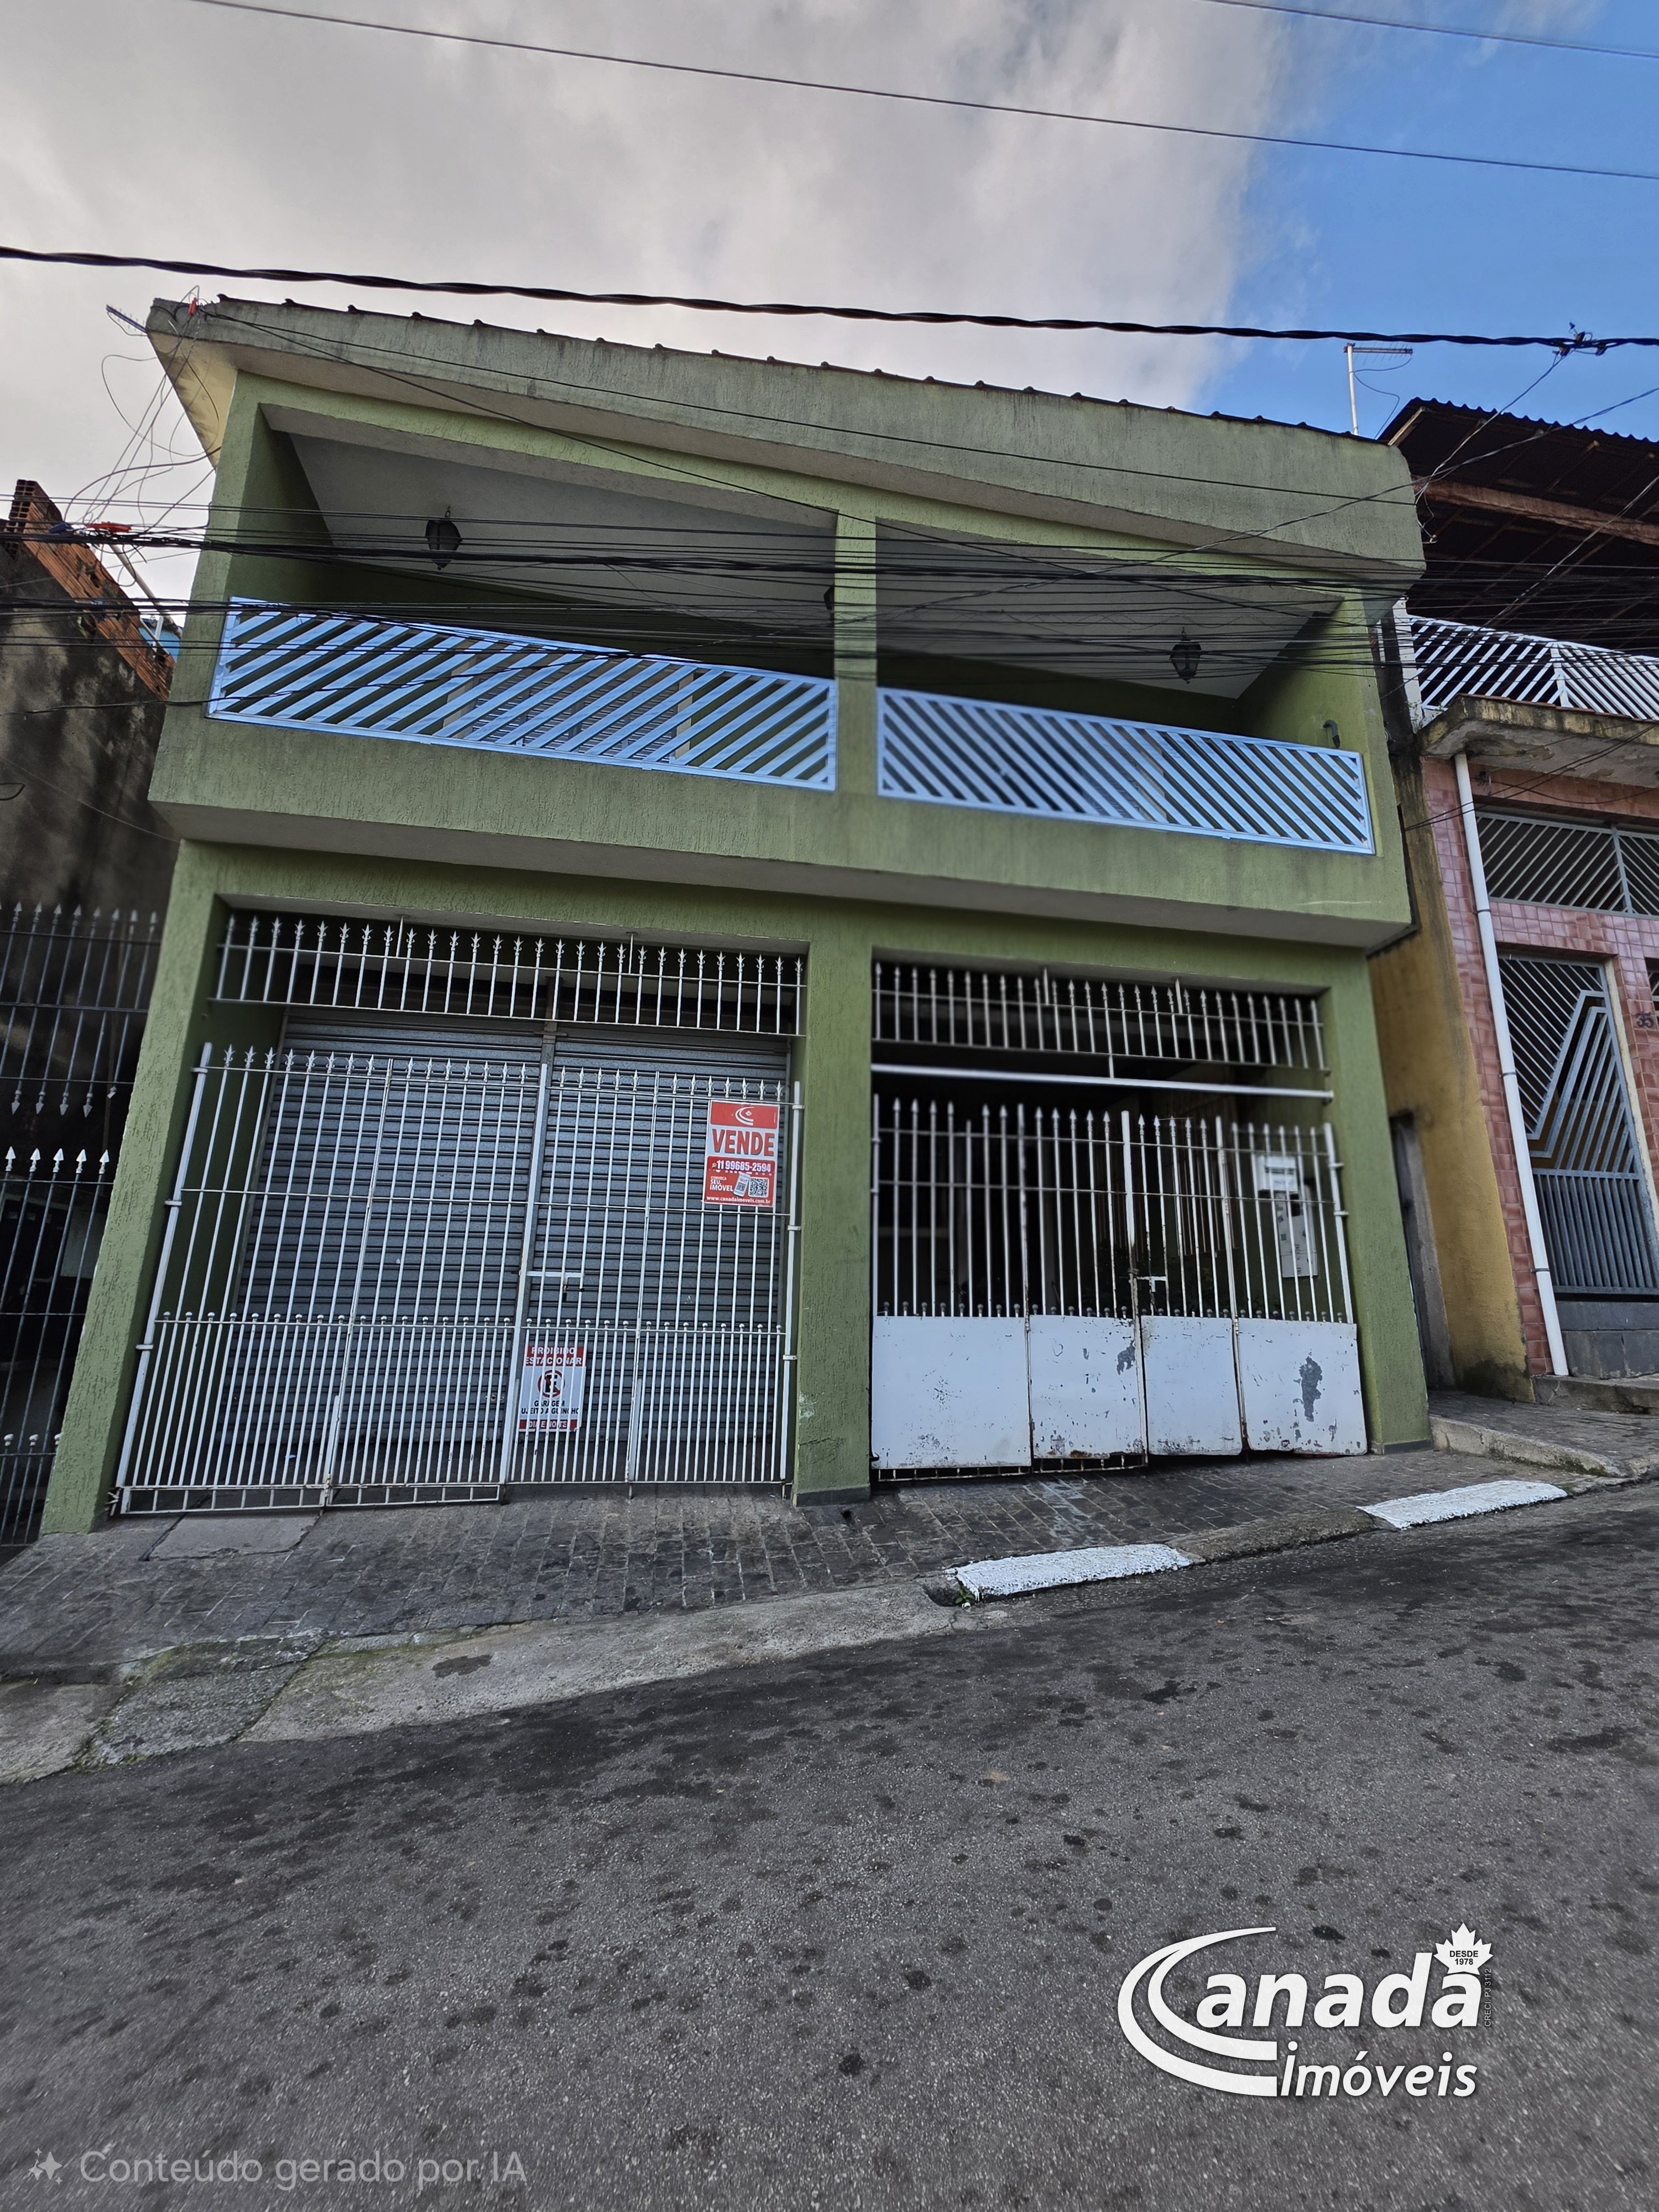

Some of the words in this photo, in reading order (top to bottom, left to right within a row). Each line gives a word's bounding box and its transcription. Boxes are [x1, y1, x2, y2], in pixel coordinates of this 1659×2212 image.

[712, 1128, 775, 1156] VENDE
[717, 1160, 724, 1169] 11
[725, 1161, 771, 1172] 99685-2594
